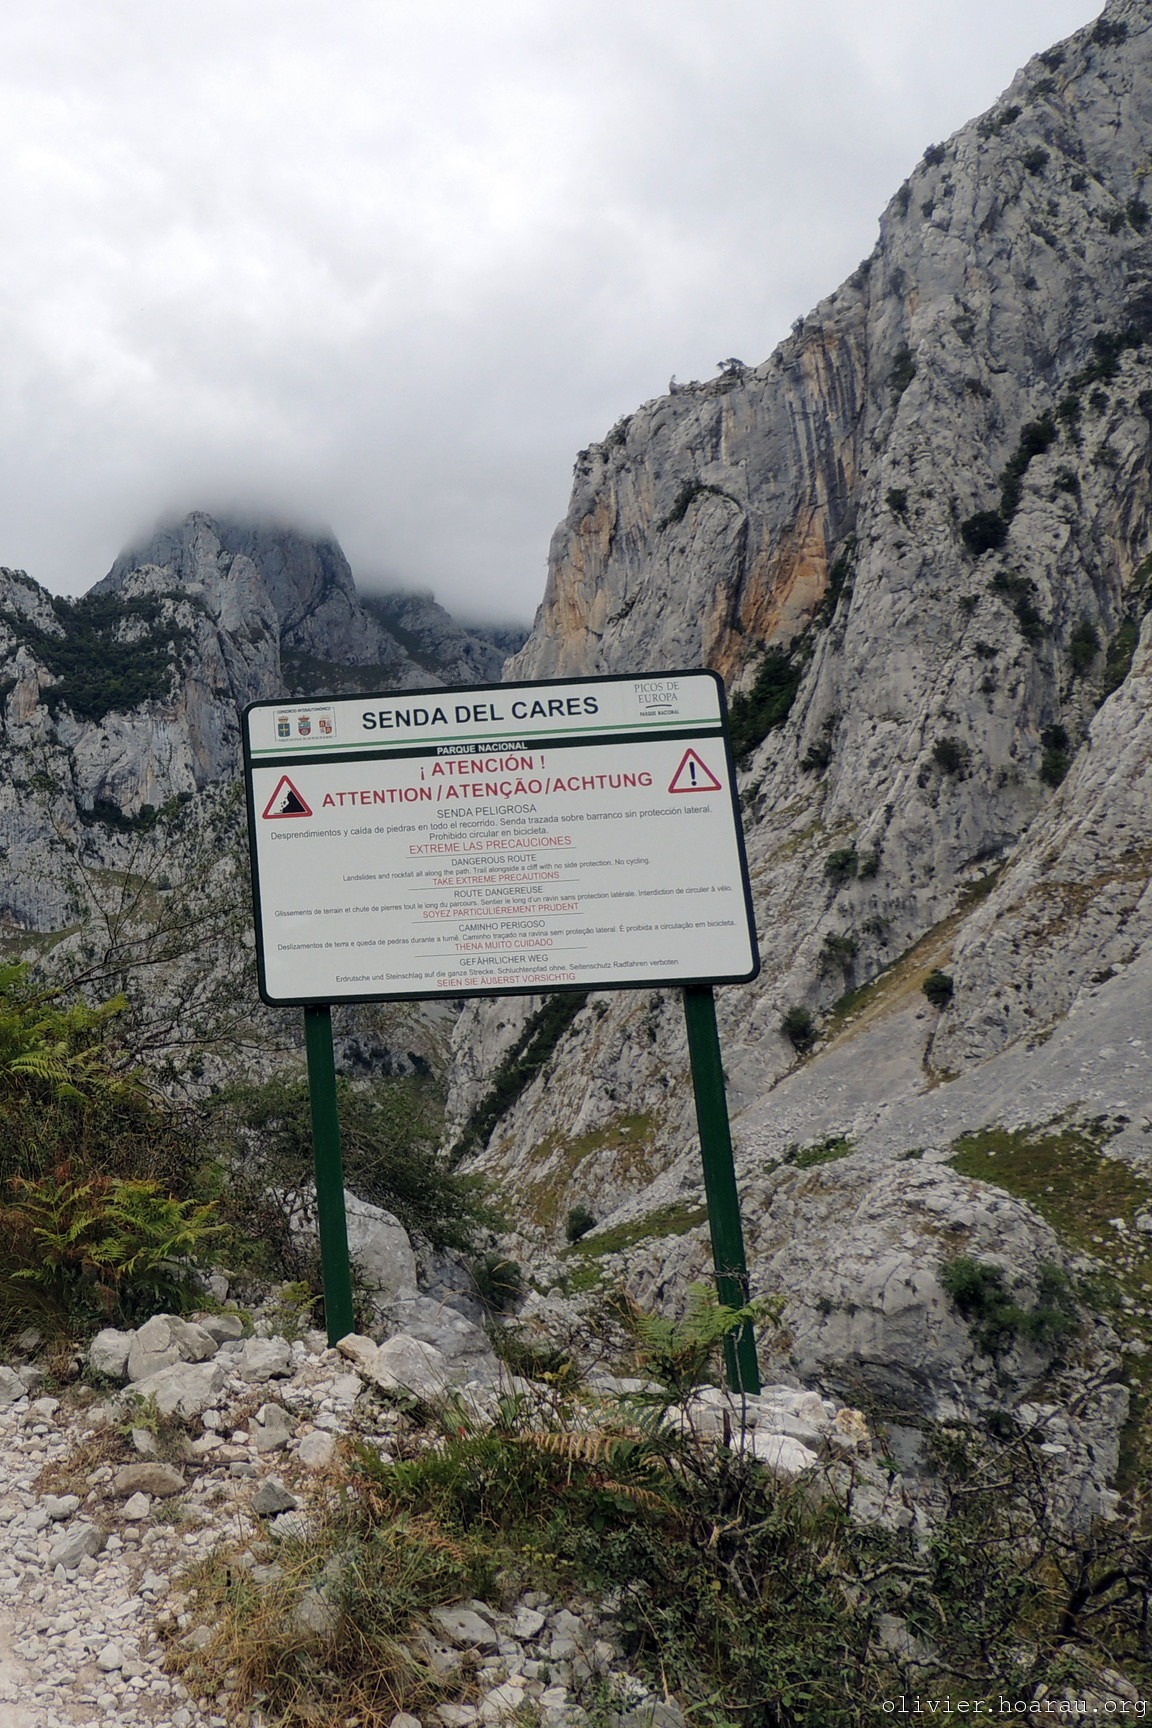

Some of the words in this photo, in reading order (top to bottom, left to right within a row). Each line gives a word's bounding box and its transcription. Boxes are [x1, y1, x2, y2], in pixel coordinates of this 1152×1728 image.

[633, 682, 663, 693] PICOS
[666, 681, 679, 690] DE
[637, 692, 678, 703] EUROPA
[362, 707, 448, 730] SENDA
[454, 703, 504, 723] DEL
[511, 696, 598, 719] CARES
[436, 744, 476, 755] PARQUE
[477, 741, 528, 752] NACIONAL
[431, 753, 533, 776] ATENCIÓN
[436, 807, 473, 818] SENDA
[475, 803, 537, 816] PELIGROSA
[270, 829, 341, 840] Desprendimientos
[343, 829, 348, 837] y
[373, 825, 384, 833] de
[386, 824, 416, 834] piedras
[430, 821, 448, 830] todo
[449, 820, 457, 829] el
[459, 818, 497, 828] recorrido.
[499, 816, 526, 826] Senda
[527, 815, 558, 824] trazada
[560, 813, 584, 822] sobre
[585, 812, 623, 820] barranco
[624, 809, 637, 818] sin
[639, 806, 682, 819] protección
[428, 831, 467, 840] Prohibido
[468, 829, 499, 838] circular
[513, 826, 549, 835] bicicleta.
[409, 842, 460, 854] EXTREME
[462, 840, 483, 851] LAS
[485, 835, 571, 849] PRECAUCIONES
[451, 855, 505, 866] DANGEROUS
[507, 853, 537, 863] ROUTE
[432, 877, 454, 885] TAKE
[455, 874, 496, 884] EXTREME
[498, 870, 559, 882] PRECAUTIONS
[453, 888, 483, 898] ROUTE
[484, 885, 543, 896] DANGEREUSE
[422, 909, 451, 918] SOYEZ
[537, 901, 579, 912] PRUDENT
[458, 922, 498, 932] CAMINHO
[500, 919, 545, 929] PERIGOSO
[454, 942, 483, 951] THENA
[484, 940, 512, 949] MUITO
[513, 937, 553, 947] CUIDADO
[527, 953, 548, 962] WEG
[436, 978, 462, 987] SEIEN
[464, 977, 478, 986] SIE
[521, 972, 575, 982] VORSICHTIG
